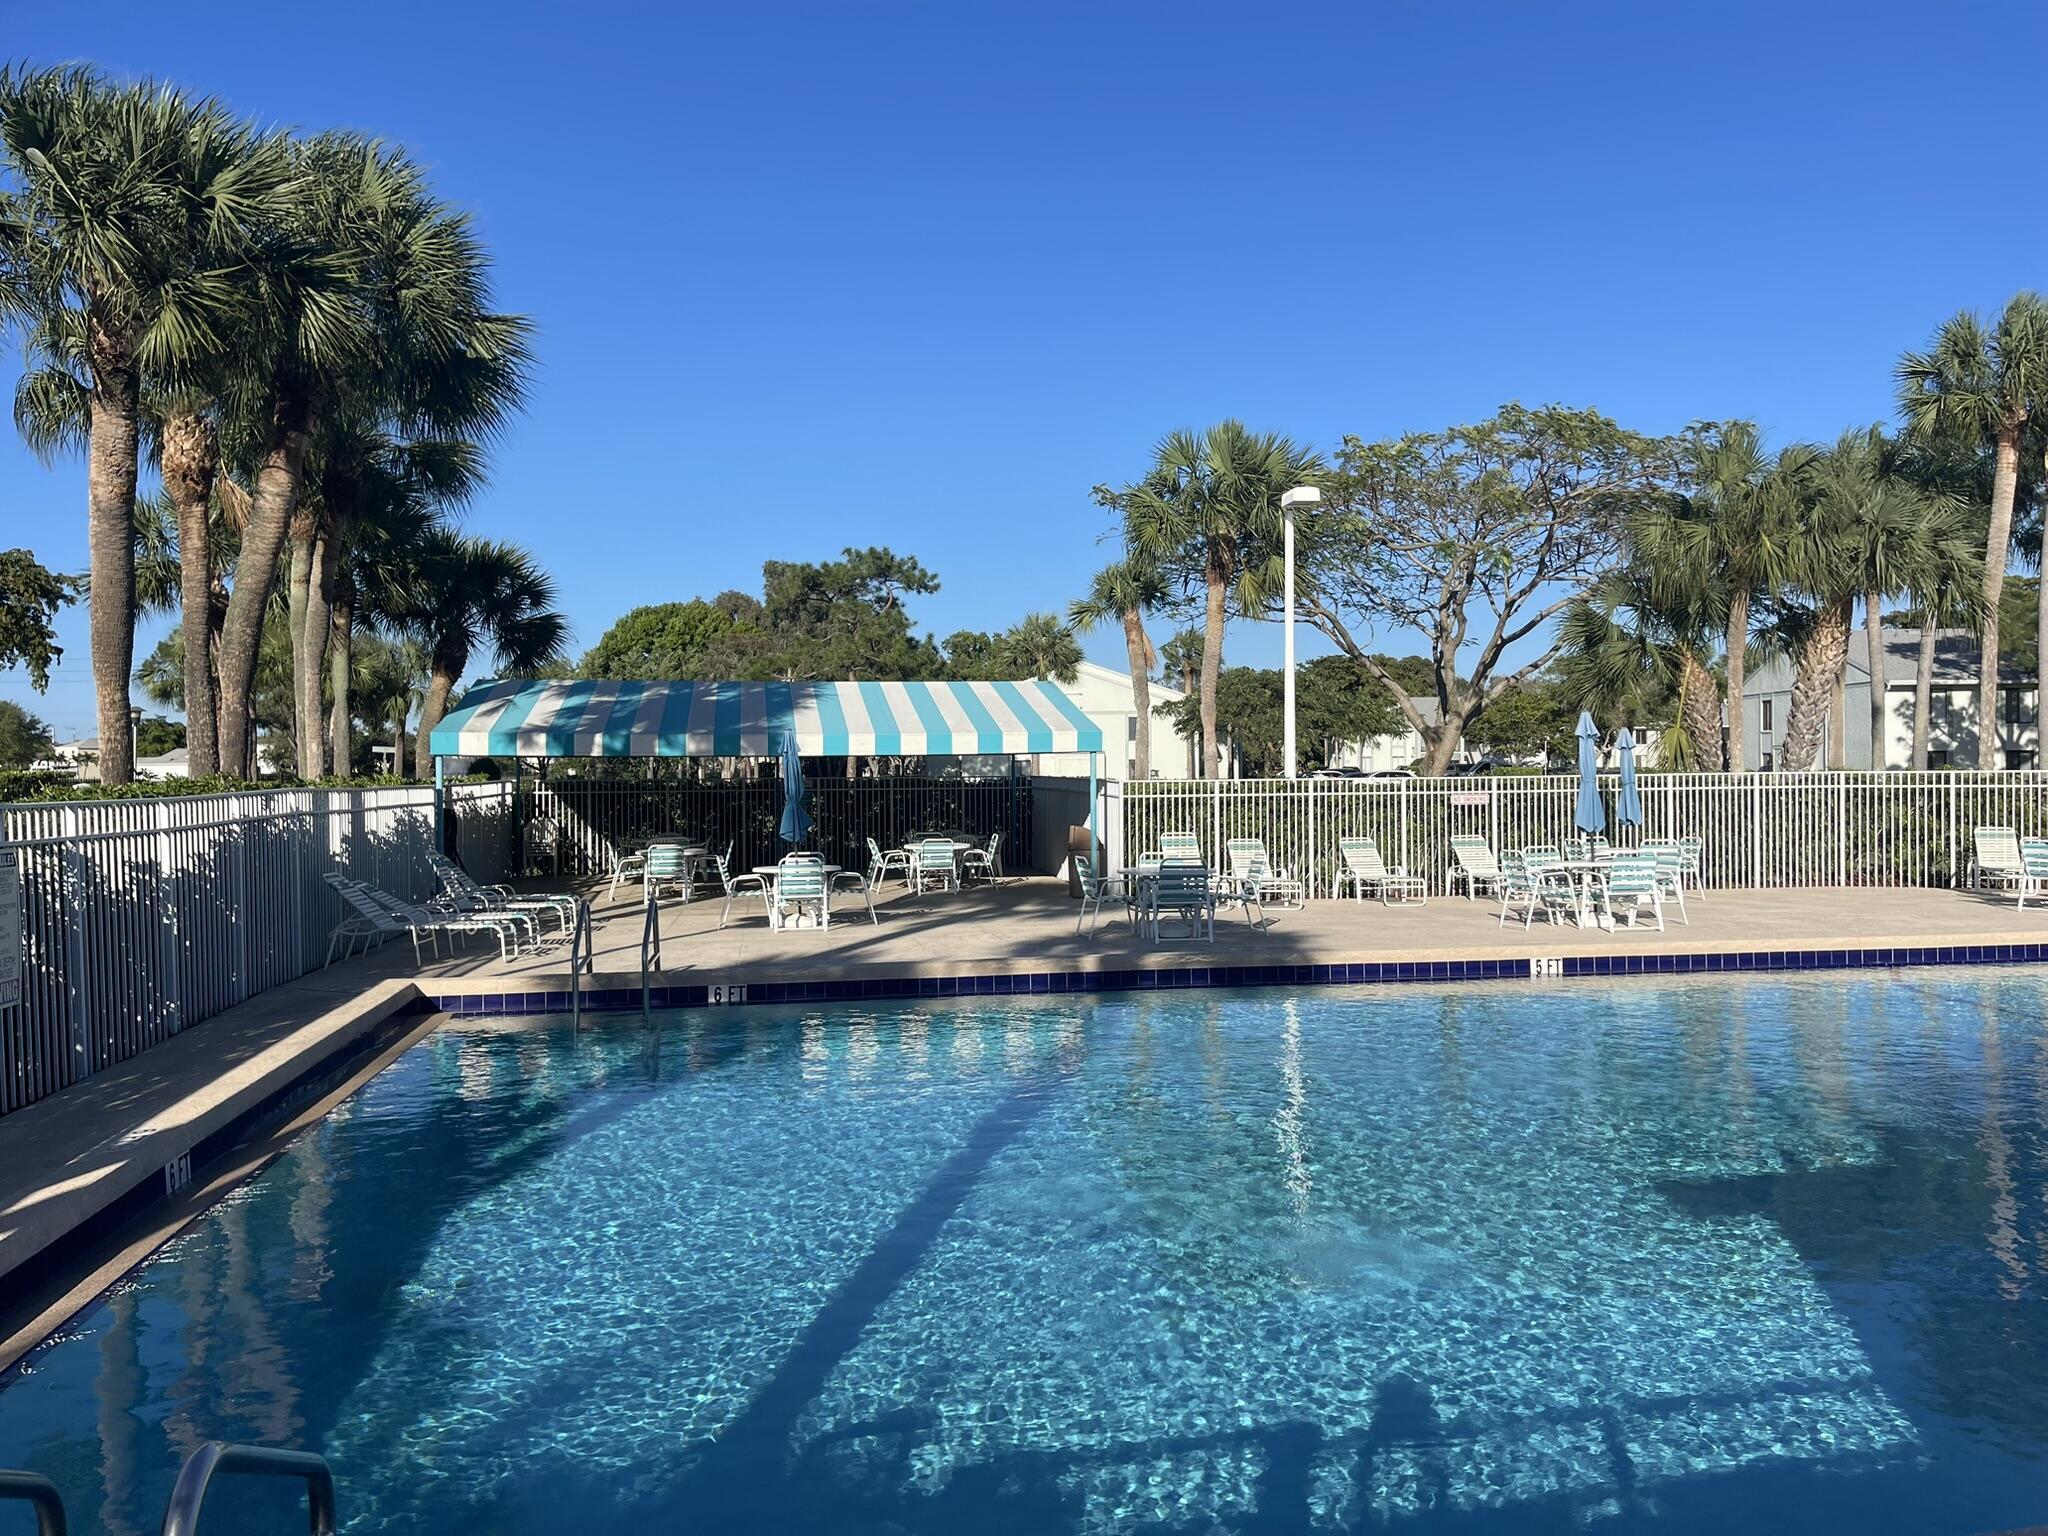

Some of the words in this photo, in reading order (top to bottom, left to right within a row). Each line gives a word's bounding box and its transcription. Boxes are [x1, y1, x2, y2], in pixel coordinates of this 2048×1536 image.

[1536, 959, 1542, 977] 5
[1547, 959, 1561, 977] FT
[714, 986, 722, 1006] 6
[728, 985, 746, 1006] FT
[170, 1162, 176, 1191] 6
[178, 1152, 190, 1184] FT
